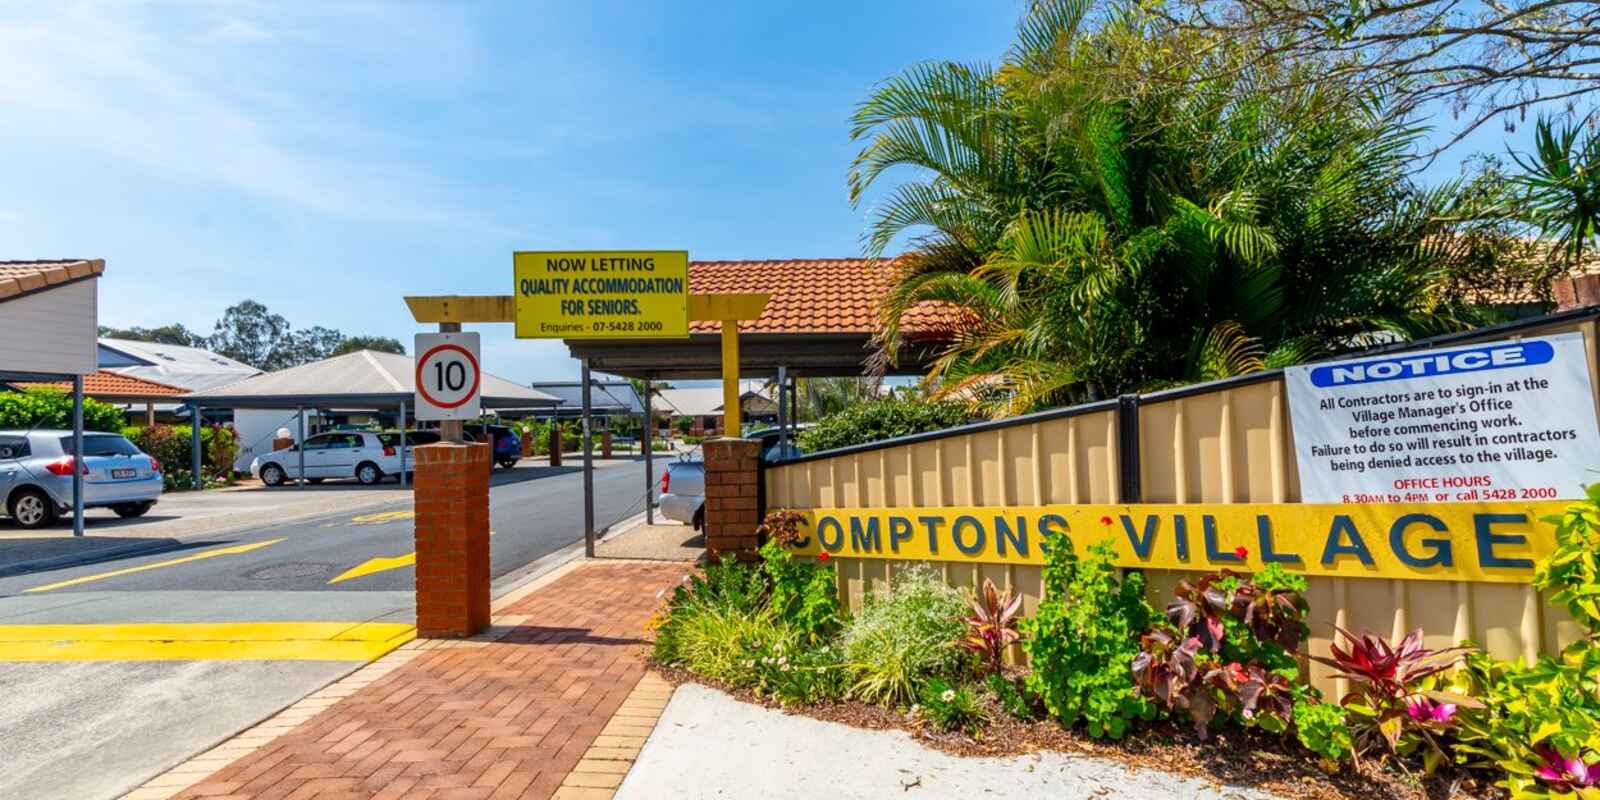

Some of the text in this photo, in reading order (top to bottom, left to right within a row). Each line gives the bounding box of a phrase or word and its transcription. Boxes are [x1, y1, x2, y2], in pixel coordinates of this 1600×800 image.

[547, 258, 655, 272] NOW LETTING
[520, 278, 682, 296] QUALITY ACCOMMODATION
[561, 299, 641, 315] FOR SENIORS.
[540, 322, 584, 333] Enquiries
[592, 322, 634, 331] 07-5428
[638, 322, 662, 331] 2000
[434, 361, 465, 391] 10
[1332, 346, 1526, 384] NOTICE
[1320, 377, 1549, 410] All Contractors are to sign-in at the
[1352, 399, 1512, 424] Village Manager's Office
[1350, 414, 1522, 439] before commencing work.
[1311, 430, 1577, 457] Failure to do so will result in contractors
[1331, 448, 1558, 472] being denied access to the village.
[1394, 476, 1491, 489] OFFICE HOURS
[1388, 492, 1400, 503] to
[1404, 492, 1428, 503] 4PM
[1436, 490, 1448, 502] or
[1456, 489, 1478, 501] call
[1482, 488, 1516, 500] 5428
[1521, 487, 1557, 499] 2000
[1119, 512, 1534, 569] VILLAGE
